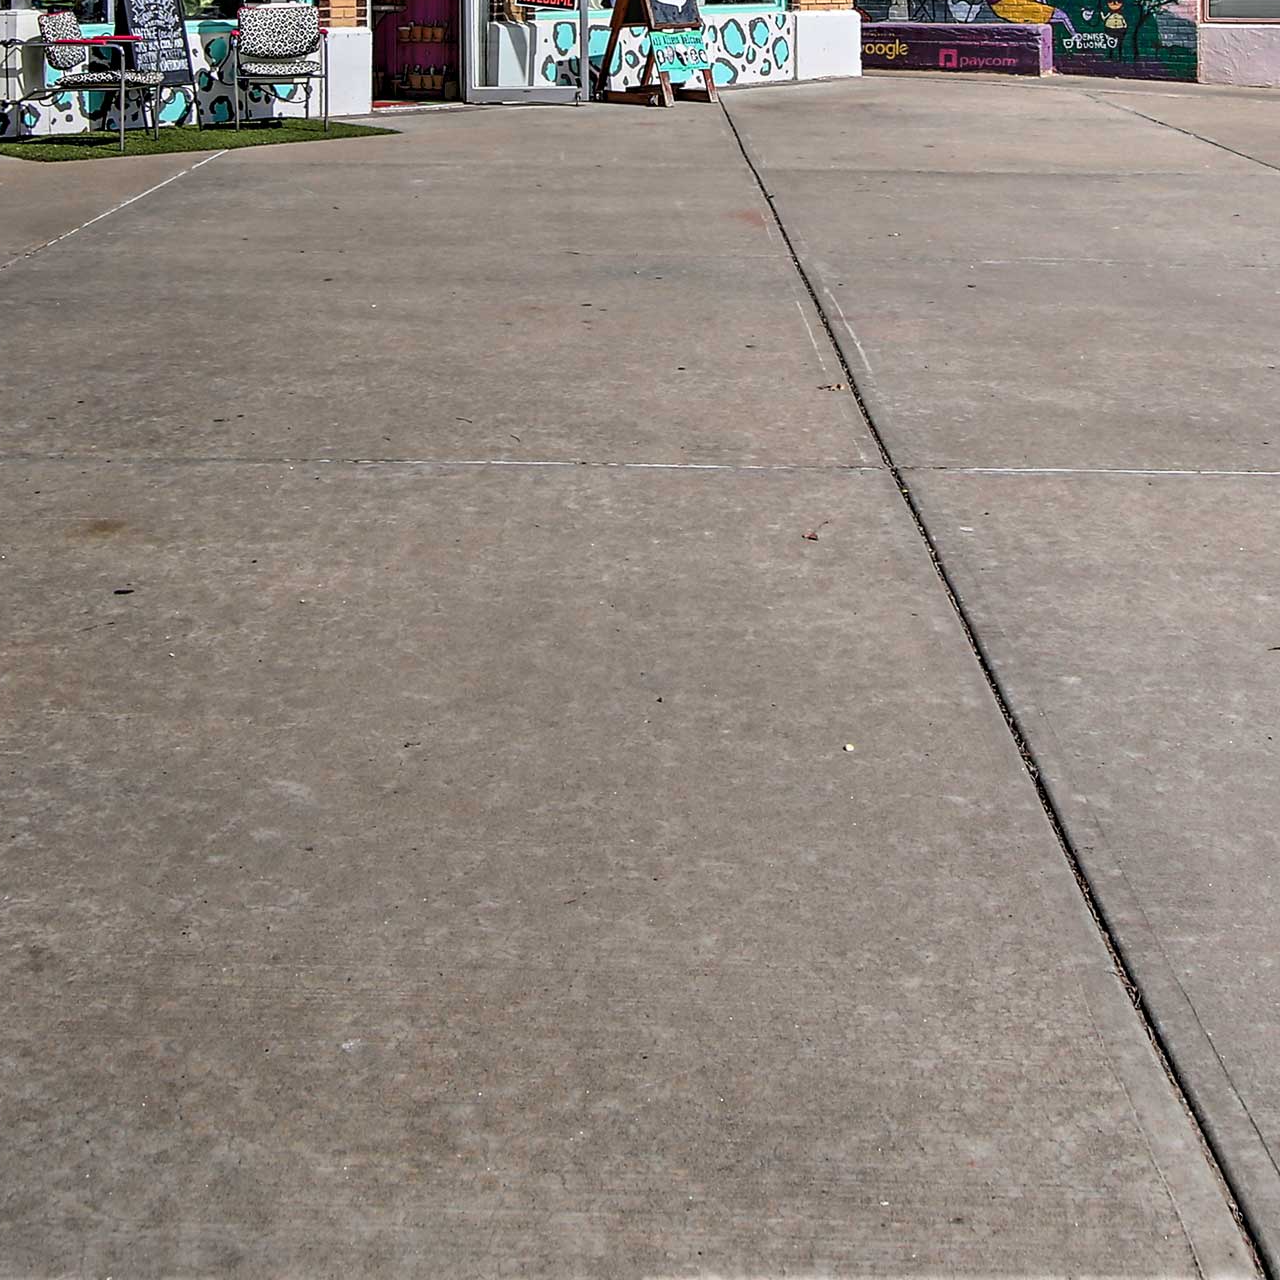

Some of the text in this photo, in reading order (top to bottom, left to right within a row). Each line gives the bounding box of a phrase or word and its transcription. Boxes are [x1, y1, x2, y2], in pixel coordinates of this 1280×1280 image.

[863, 39, 909, 60] oogle
[1076, 41, 1107, 49] DUONG
[959, 57, 1017, 68] paycom
